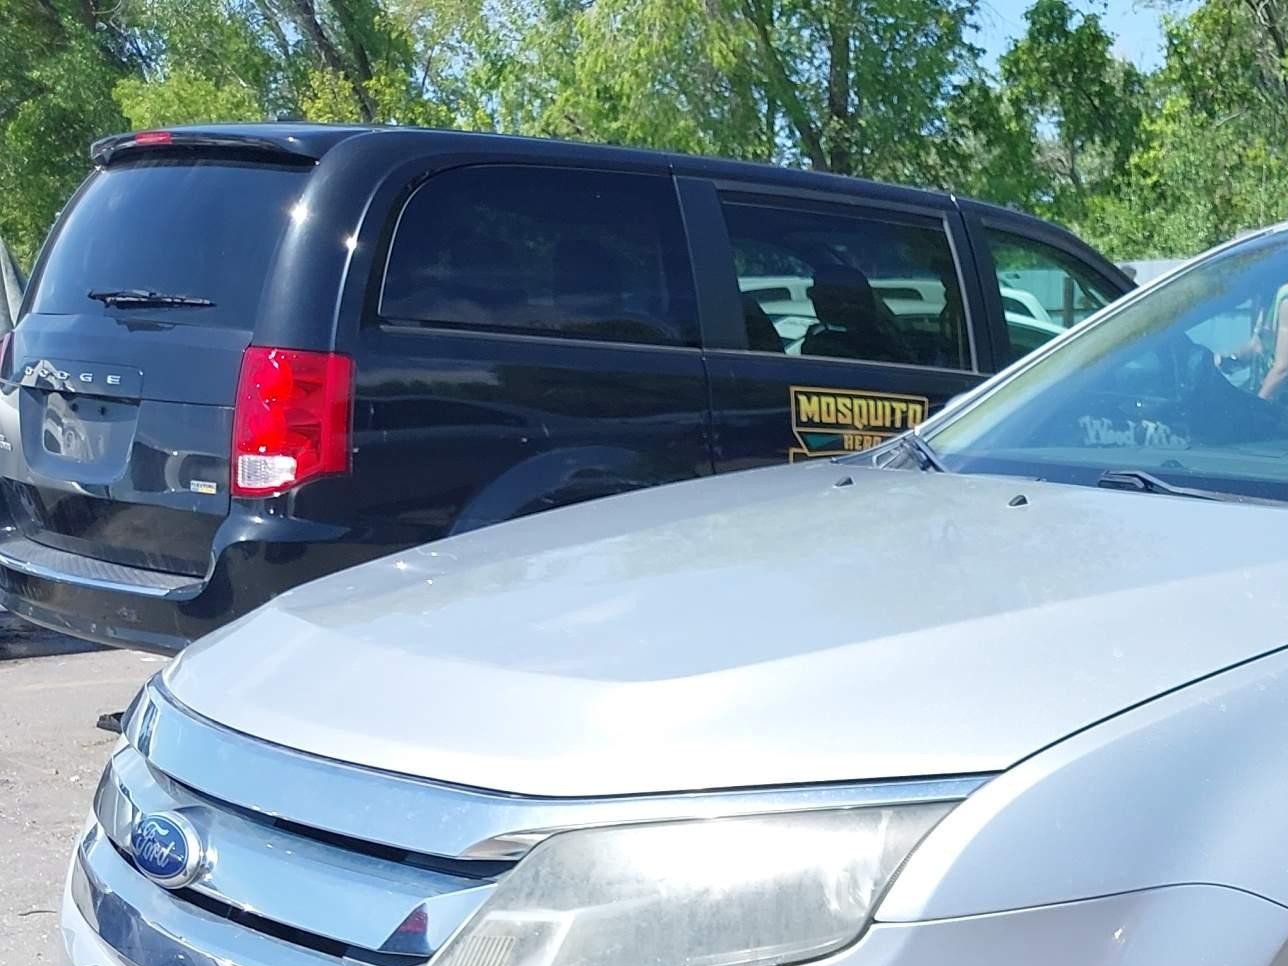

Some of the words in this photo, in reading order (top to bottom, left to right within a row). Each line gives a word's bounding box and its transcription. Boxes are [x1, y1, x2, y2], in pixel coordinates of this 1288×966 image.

[24, 365, 121, 385] DODGE
[797, 394, 923, 430] MOSQUITO
[133, 821, 183, 868] Ford
